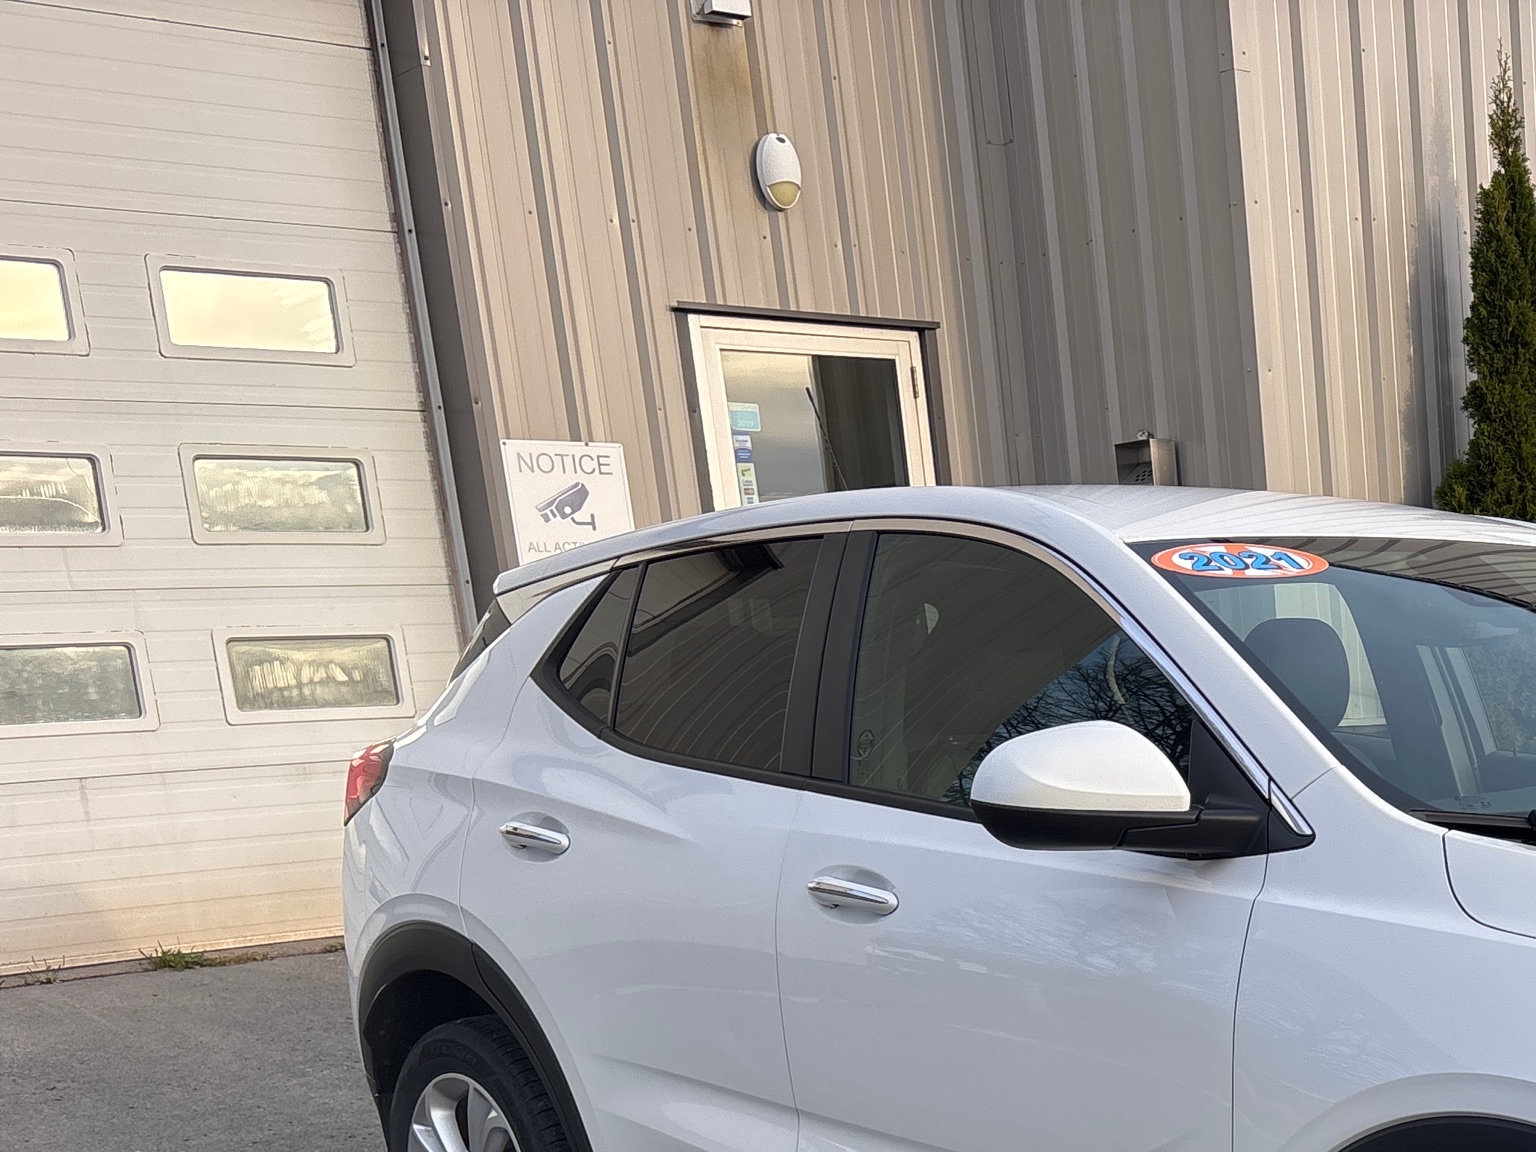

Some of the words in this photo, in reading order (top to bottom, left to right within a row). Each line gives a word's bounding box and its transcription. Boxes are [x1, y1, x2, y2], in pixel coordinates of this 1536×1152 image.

[516, 452, 614, 476] NOTICE
[527, 541, 552, 553] ALL
[1180, 550, 1304, 572] 2021
